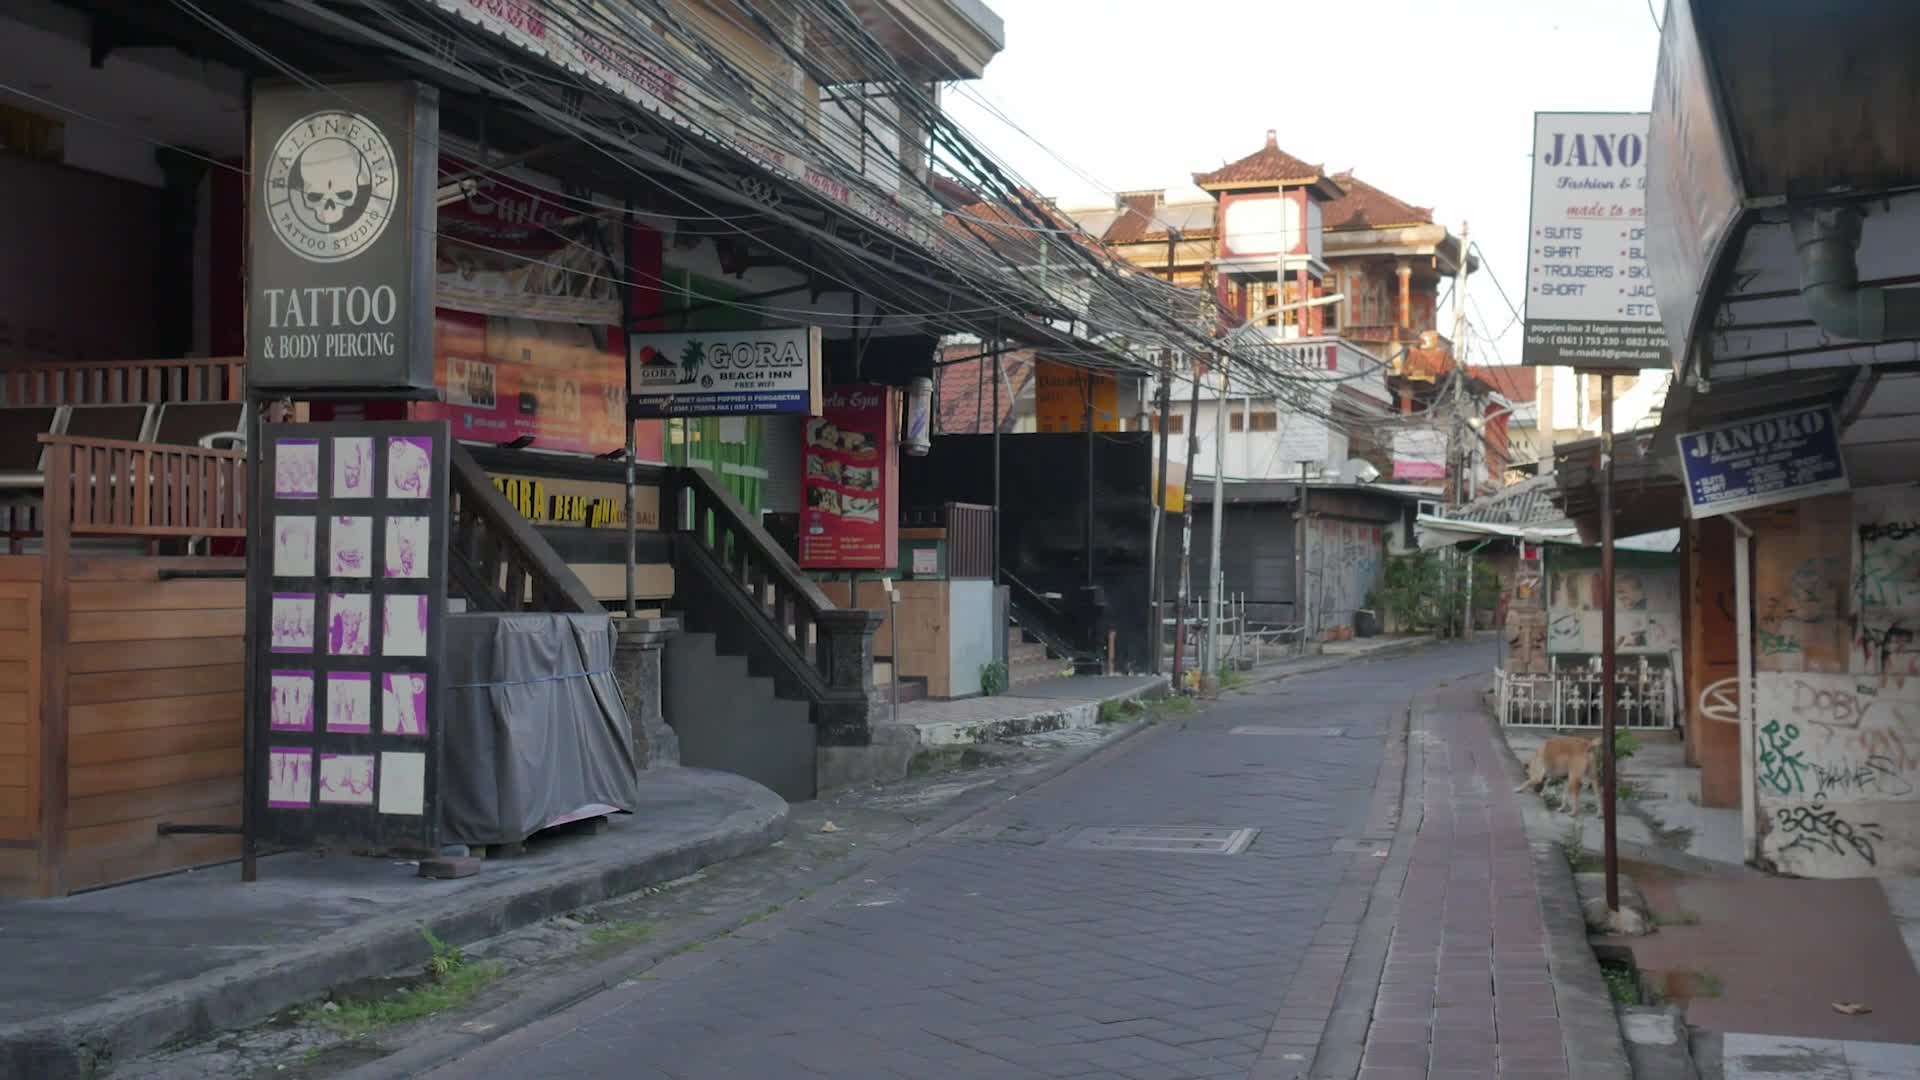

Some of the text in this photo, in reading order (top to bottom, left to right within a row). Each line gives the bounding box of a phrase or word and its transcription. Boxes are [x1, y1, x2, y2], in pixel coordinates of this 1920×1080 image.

[1544, 133, 1648, 168] JANO
[1556, 175, 1614, 191] Fashion
[1566, 202, 1604, 217] made
[1610, 202, 1623, 217] to
[280, 209, 380, 251] TATTOO STUDIO
[1544, 227, 1583, 240] SUITS
[1543, 246, 1582, 259] SHIRT
[1544, 265, 1614, 278] TROUSERS
[1541, 284, 1586, 297] SHORT
[263, 285, 397, 328] TATTOO
[1626, 304, 1654, 317] ETC
[1531, 324, 1566, 337] poppies
[263, 332, 395, 359] & BODY PIERCING
[708, 341, 803, 369] GORA
[641, 367, 677, 378] GORA
[719, 370, 792, 381] BEACH INN
[1690, 411, 1825, 458] JANOKO
